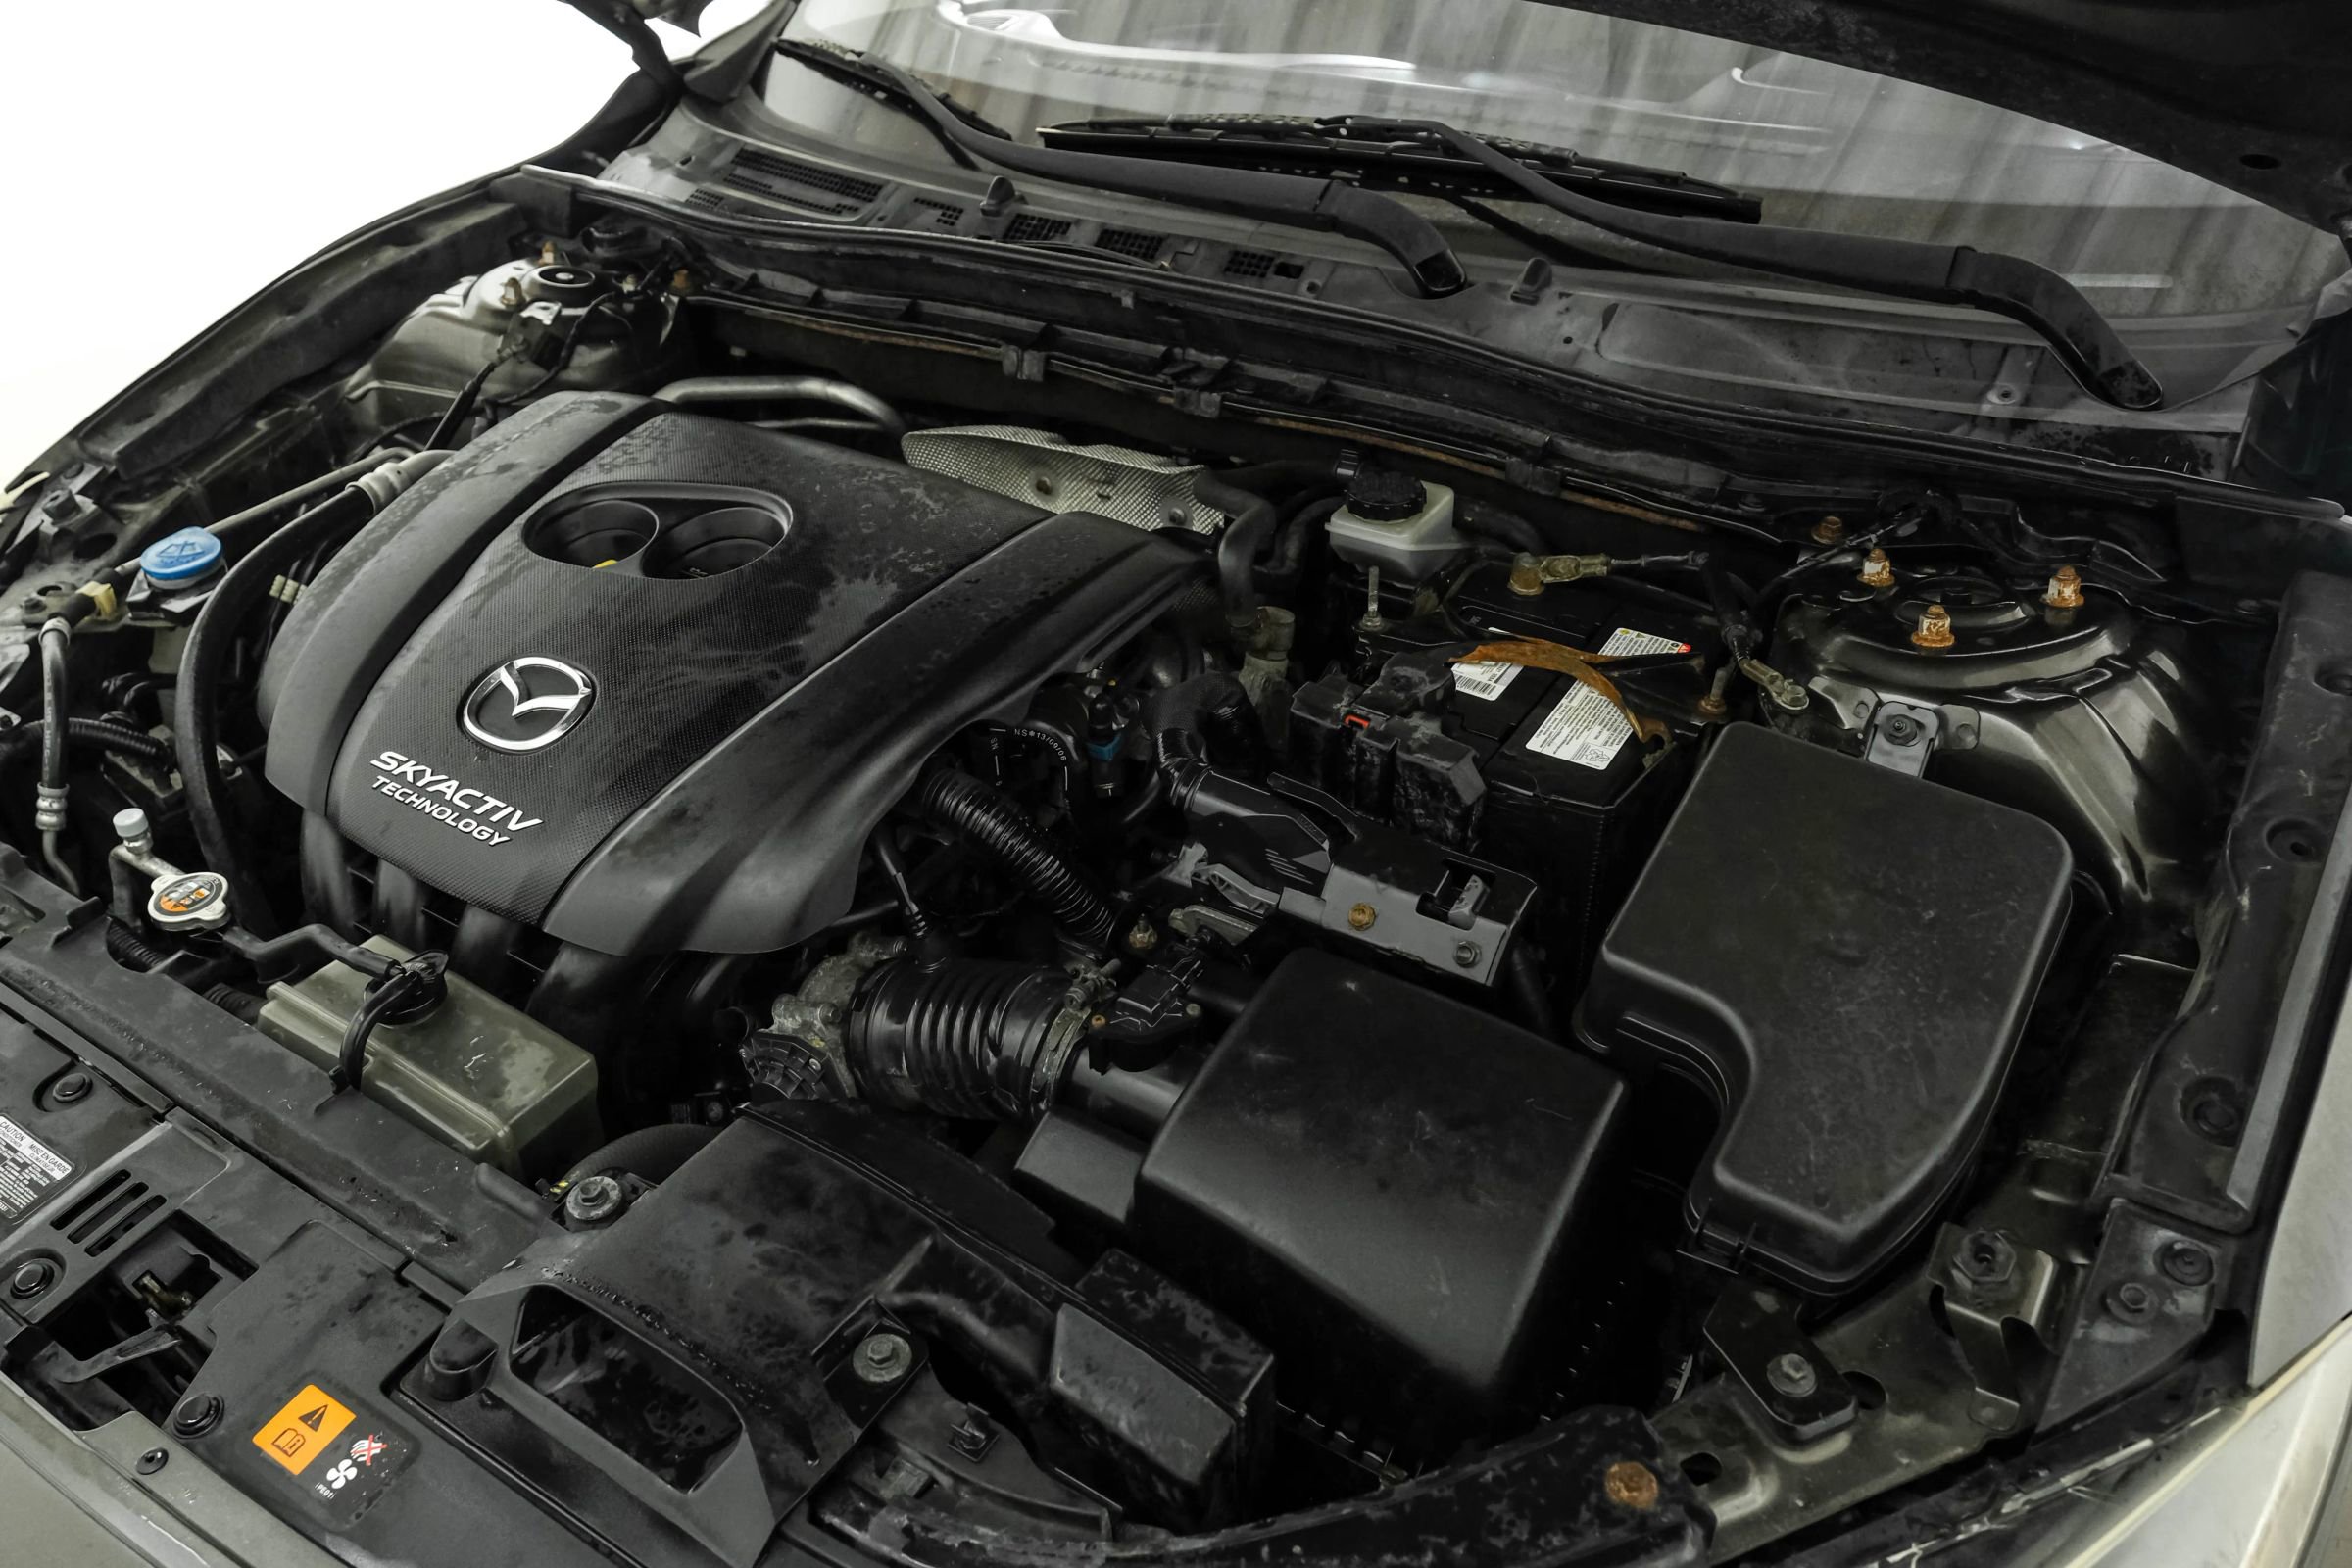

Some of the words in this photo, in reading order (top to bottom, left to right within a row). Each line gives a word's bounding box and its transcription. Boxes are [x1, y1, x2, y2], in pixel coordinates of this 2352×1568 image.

[370, 751, 544, 832] SKYACTIV
[372, 775, 512, 846] TECHNOLOGY
[0, 1121, 26, 1142] CAUTION
[29, 1143, 44, 1155] MISE
[40, 1152, 52, 1161] EN
[48, 1157, 71, 1174] GARDE
